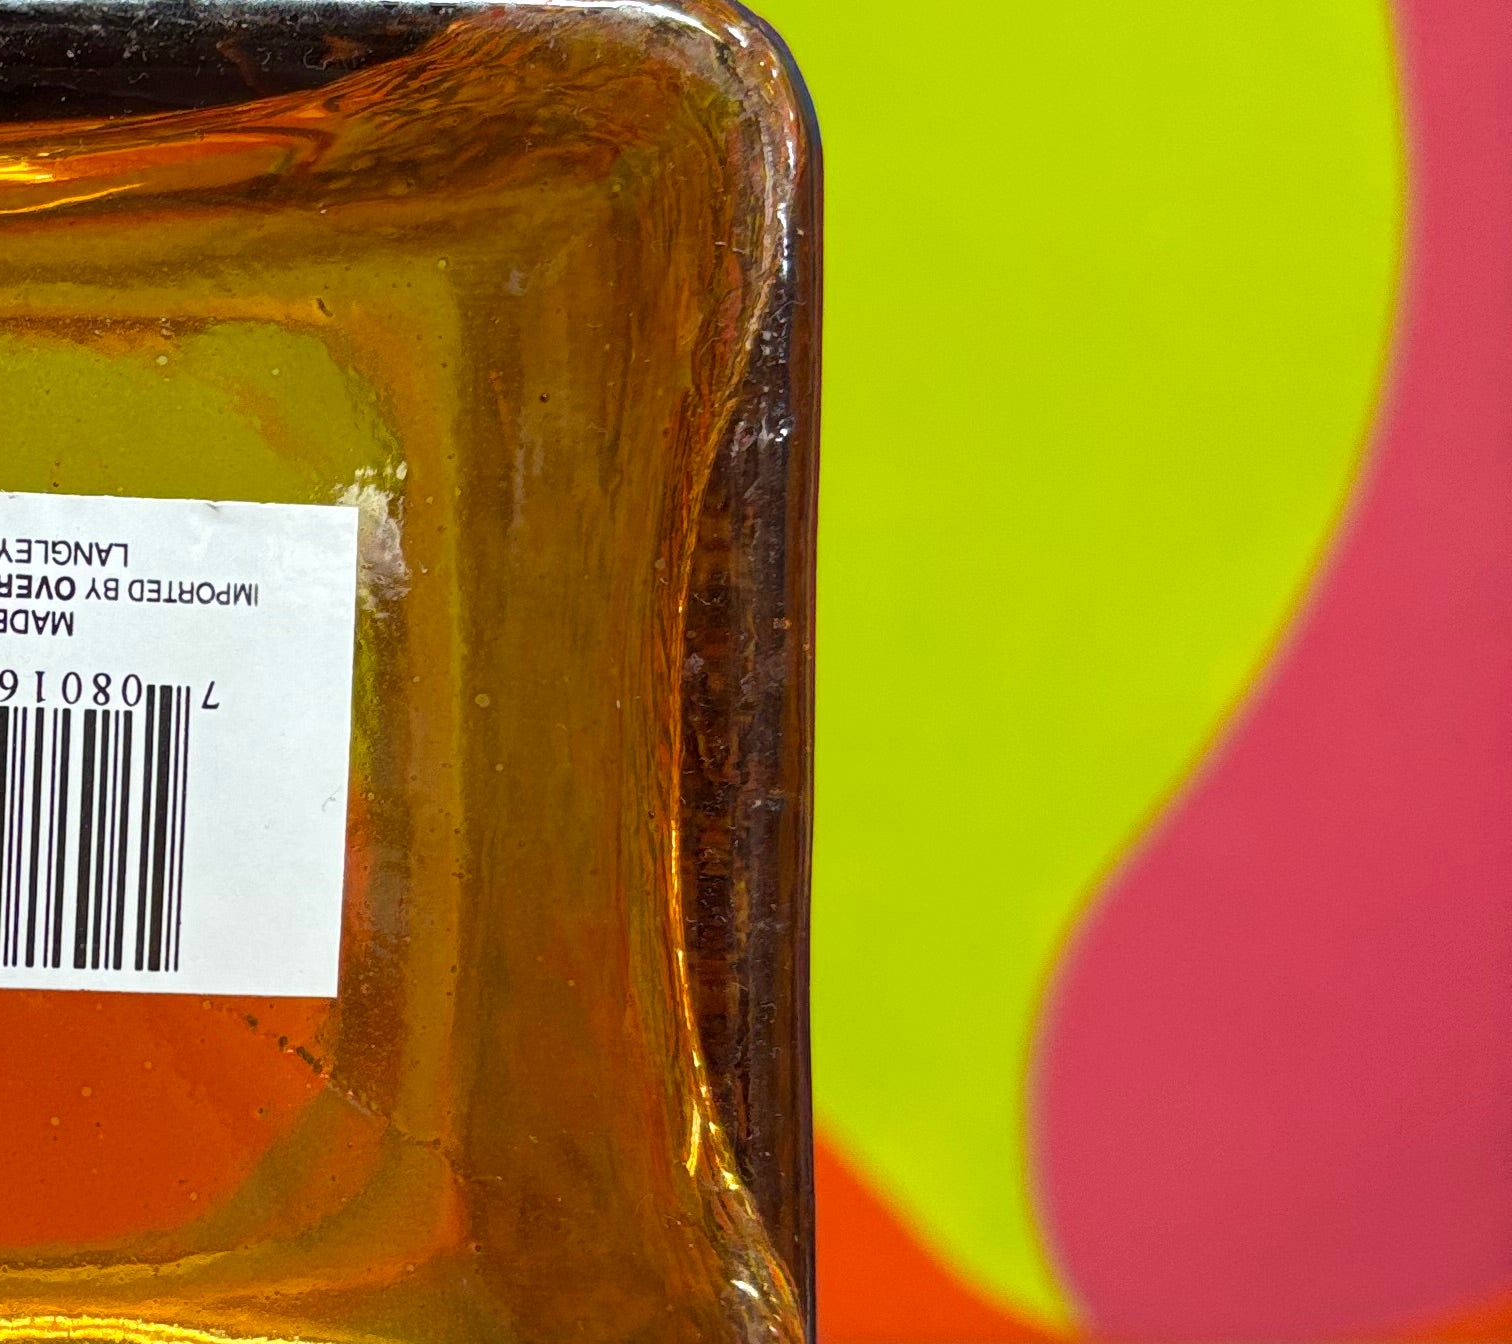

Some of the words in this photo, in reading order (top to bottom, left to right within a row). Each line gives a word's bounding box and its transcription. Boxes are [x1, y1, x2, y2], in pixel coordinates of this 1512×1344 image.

[85, 577, 119, 601] BY
[128, 578, 259, 606] IMPORTED
[201, 681, 220, 709] 7
